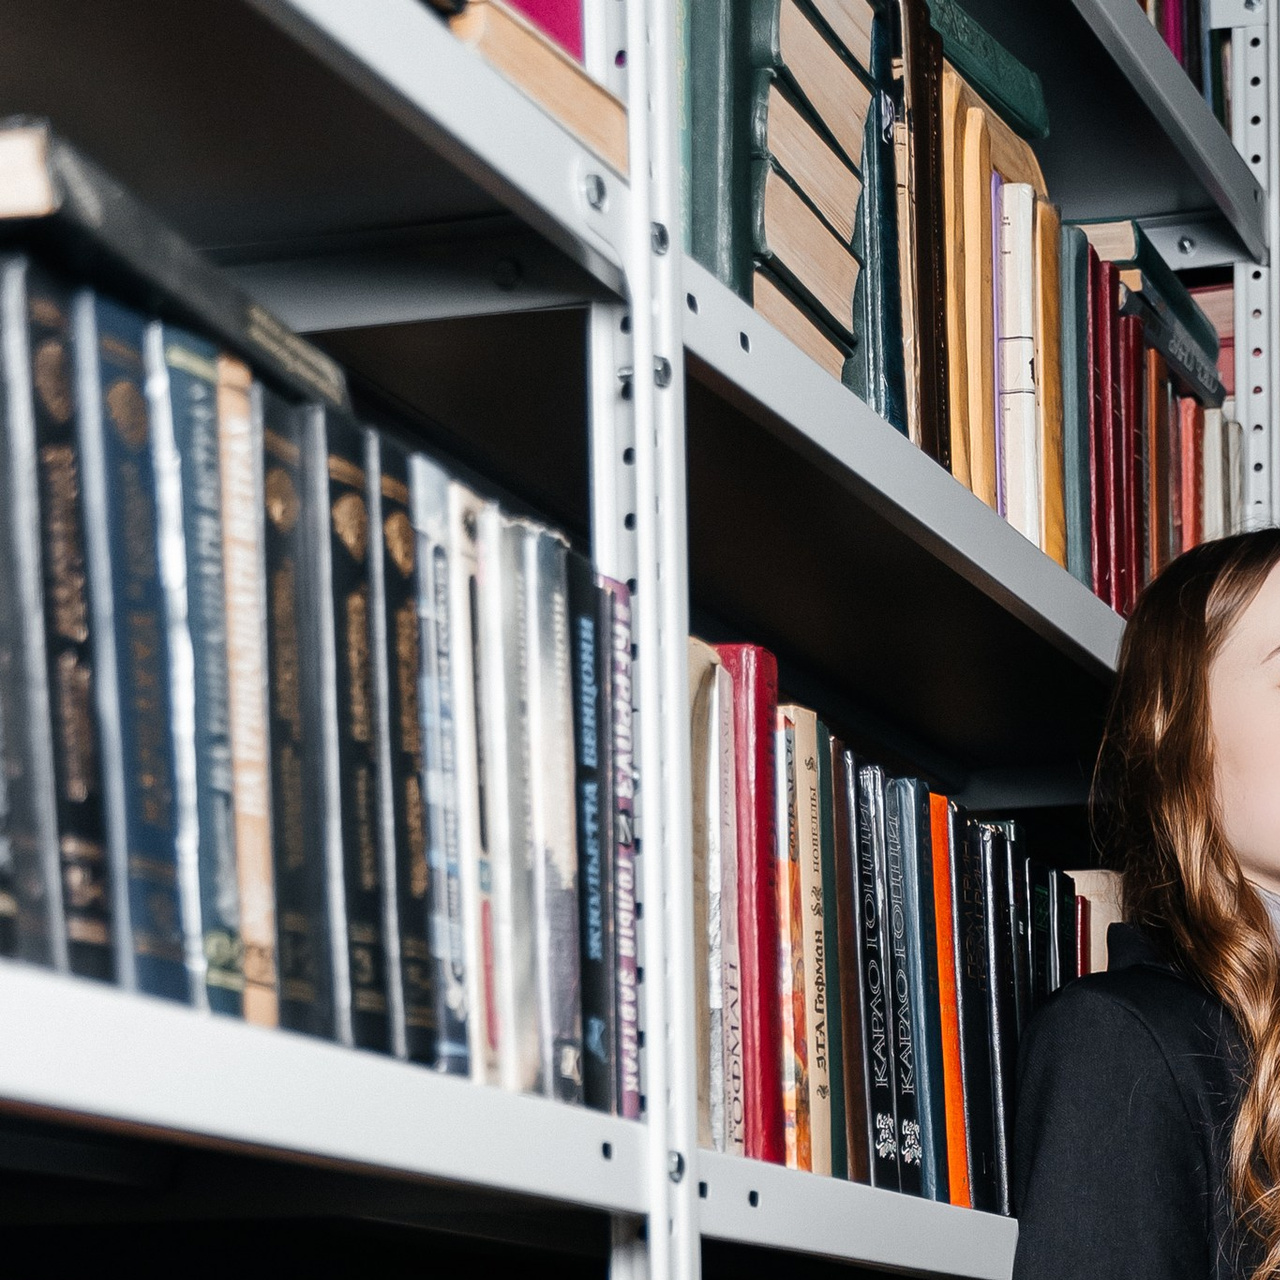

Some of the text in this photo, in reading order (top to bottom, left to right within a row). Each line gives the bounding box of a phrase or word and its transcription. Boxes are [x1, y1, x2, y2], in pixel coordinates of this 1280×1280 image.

[808, 786, 819, 873] НОВЕЛЛЫ
[971, 854, 984, 918] ГРИН
[811, 929, 826, 1014] Гофман
[855, 798, 889, 1088] КАРЛО ГОЦЦИ
[883, 811, 916, 1094] КАРЛО ГОЦЦИ
[959, 839, 976, 979] ГРЭМ ГРИН
[725, 962, 745, 1143] ГОФМАН
